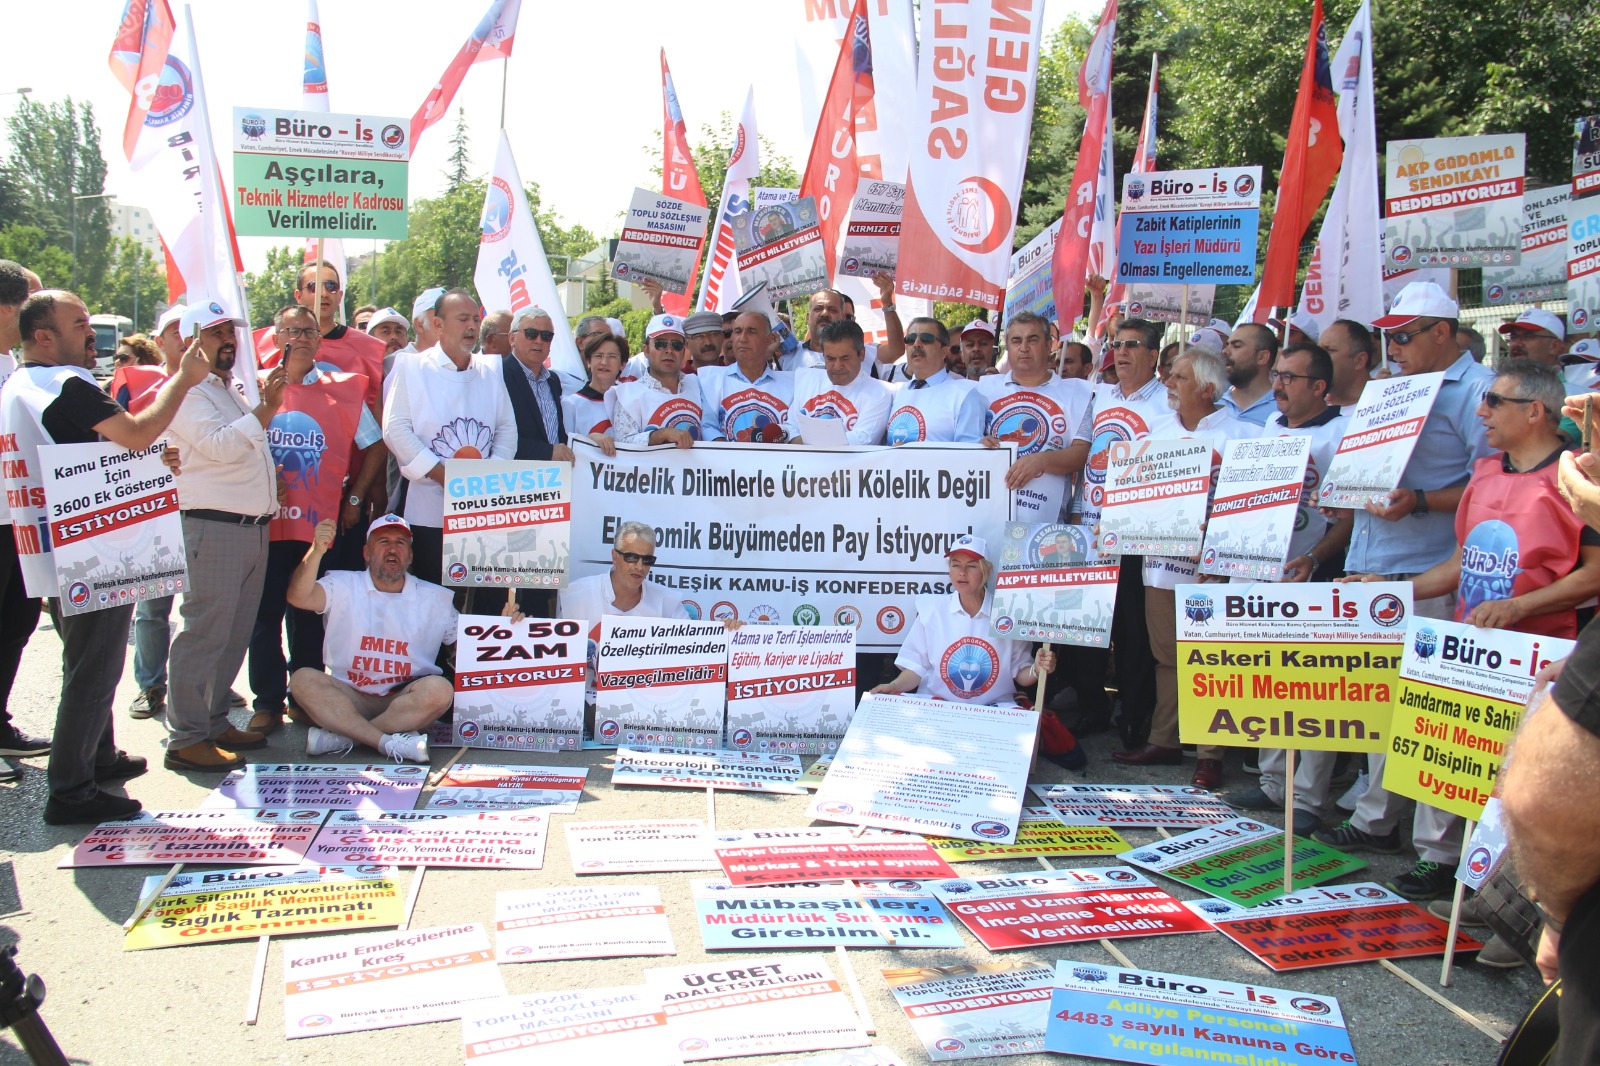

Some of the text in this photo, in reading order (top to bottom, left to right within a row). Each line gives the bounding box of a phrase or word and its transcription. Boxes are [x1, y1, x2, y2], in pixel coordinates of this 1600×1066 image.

[275, 118, 332, 138] Büro
[1396, 146, 1515, 178] AKP GÜDÜMLÜ
[265, 161, 384, 189] Aşçılara,
[1151, 180, 1193, 195] Büro
[238, 187, 403, 210] Teknik Hizmetler Kadrosu
[656, 200, 682, 210] SÖZDE
[268, 210, 377, 231] Verilmelidir.
[632, 209, 702, 223] TOPLU SÖZLEŞME
[1136, 215, 1241, 234] Zabit Katiplerinin
[1528, 211, 1541, 220] VE
[647, 221, 686, 232] MASASINI
[1134, 236, 1241, 257] Yazı İşleri Müdürü
[1121, 262, 1252, 280] Olması Engellenemez.
[1382, 380, 1412, 398] SÖZDE
[1356, 386, 1431, 419] TOPLU SÖZLEŞME
[1367, 407, 1409, 428] MASASINI
[1156, 446, 1206, 460] ORANLARA
[54, 461, 96, 480] Kamu
[105, 468, 130, 484] İçin
[1115, 464, 1200, 486] TOPLU SÖZLEŞMEYİ
[1142, 461, 1172, 472] DAYALI
[590, 462, 990, 507] Yüzdelik Dilimlerle Ücretli Kölelik Değil
[54, 474, 172, 516] 3600 Ek Gösterge
[452, 499, 487, 510] TOPLU
[1212, 498, 1246, 514] KIRMIZI
[59, 496, 168, 539] İSTİYORUZ
[709, 522, 827, 558] Büyümeden
[833, 524, 869, 561] Pay
[472, 565, 493, 574] Birleşik
[1165, 563, 1195, 576] Mevzi
[1462, 546, 1519, 578] BÜRO-İŞ
[94, 580, 116, 590] Birleşik
[141, 569, 185, 581] Konfederasyonu
[644, 571, 809, 596] İRLEŞİK KAMU-İŞ
[1226, 595, 1299, 618] Büro
[528, 621, 580, 638] 50
[611, 624, 724, 639] Kamu Varlıklarının
[731, 627, 853, 647] Atama ve Terfi İşlemlerinde
[1205, 631, 1242, 639] Cumhuriyet,
[1262, 631, 1309, 639] Mücadelesinde
[1337, 632, 1358, 640] Milliye
[360, 635, 408, 657] EMEK
[476, 643, 568, 662] ZAM
[601, 641, 726, 658] Özelleştirilmesinden
[352, 655, 412, 676] EYLEM
[731, 651, 843, 670] Eğitim, Kariyer ve Liyakat
[1187, 649, 1271, 667] Askeri
[461, 668, 573, 688] İSTİYORUZ
[600, 667, 715, 688] Vazgeçilmelidir
[1193, 672, 1391, 703] Sivil Memurlara
[1400, 686, 1480, 723] Jandarma ve
[483, 724, 505, 732] Birleşik
[531, 726, 580, 735] Konfederasyonu
[1207, 708, 1380, 742] Açılsın.
[1415, 716, 1448, 741] Sivil
[1392, 735, 1482, 777] 657 Disiplin
[340, 836, 521, 846] Çalışanlarına
[465, 829, 538, 837] Merkezi
[317, 844, 536, 855] Yıpranma Payı, Yemek Ücreti, Mesai
[344, 853, 511, 864] Ödenmelidir.
[957, 889, 1171, 916] Gelir Uzmanlarına
[976, 902, 1182, 929] İnceleme Yetkisi
[1230, 907, 1420, 936] SGK çalışanlarının
[1021, 918, 1173, 939] Verilmelidir.
[1252, 921, 1440, 949] Havuz Paraları
[290, 925, 474, 969] Kamu Emekçilerine
[1259, 946, 1354, 964] Tekrar
[362, 952, 406, 968] Kreş
[905, 986, 944, 997] TOPLU
[1106, 998, 1299, 1036] Adliye Personeli
[1055, 1009, 1355, 1064] 4483 sayılı Kanuna Göre
